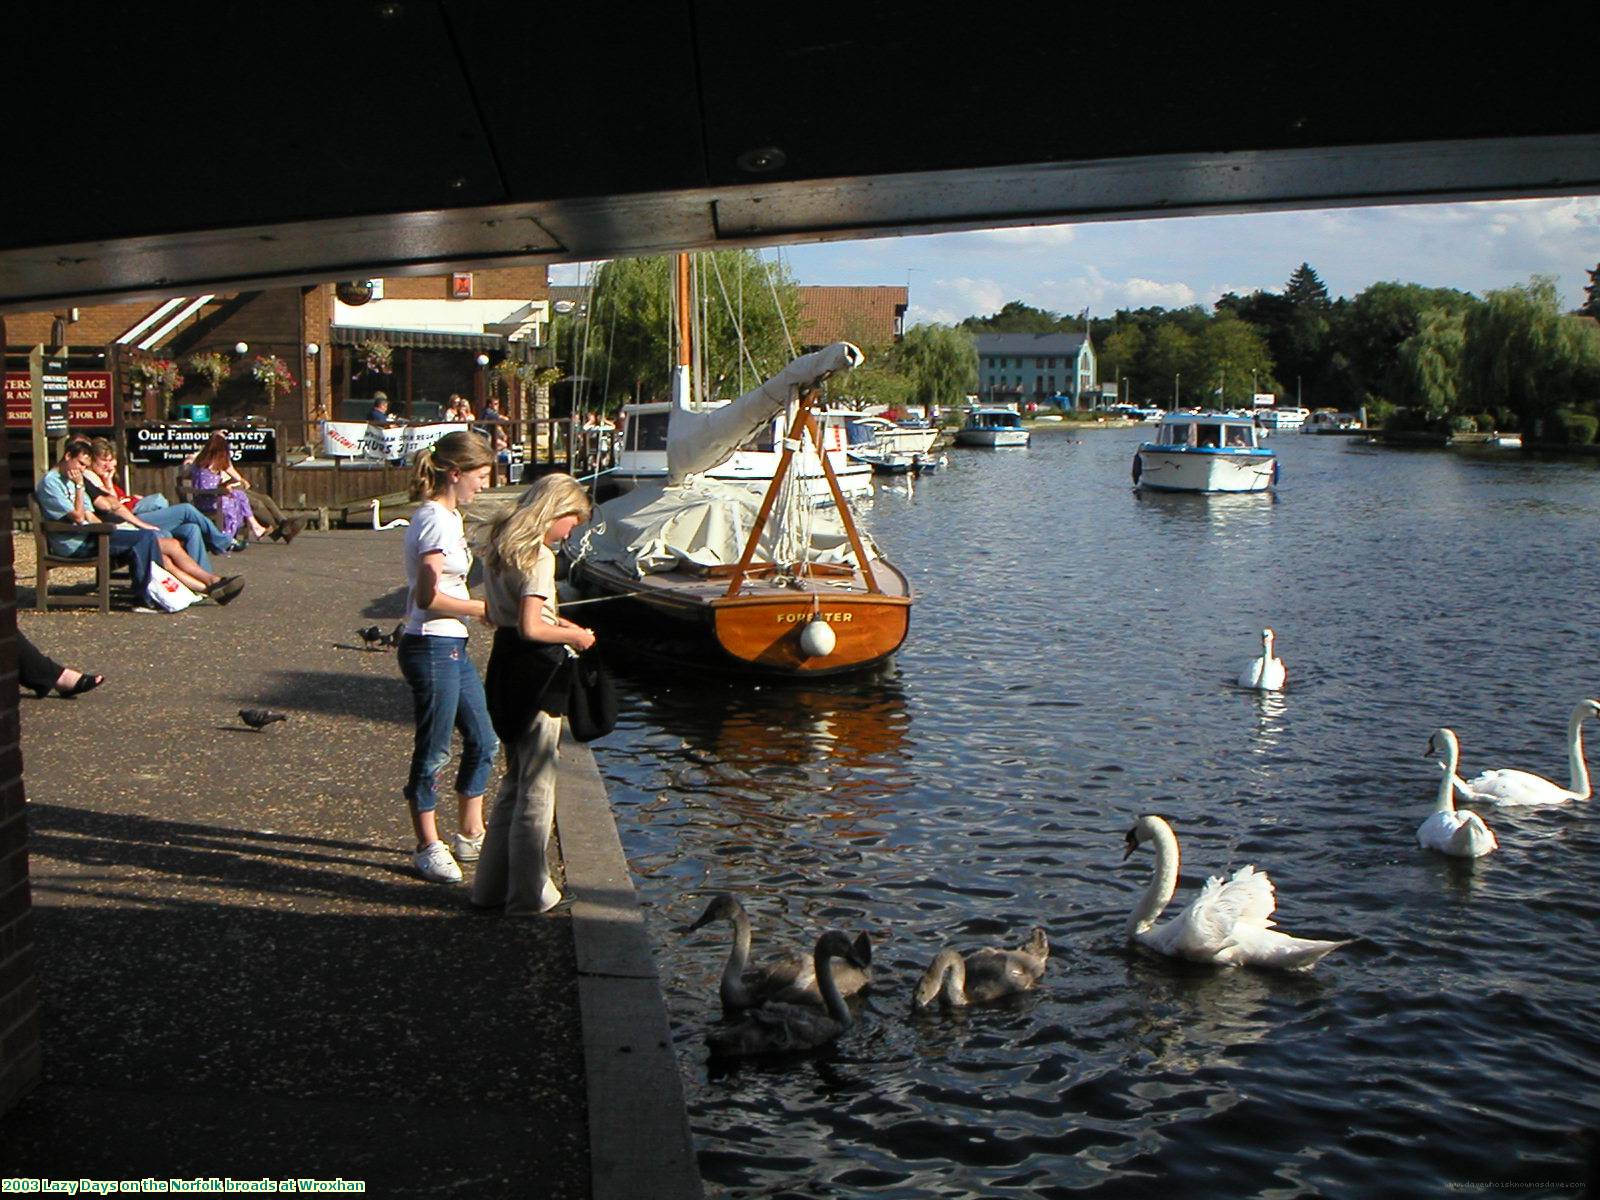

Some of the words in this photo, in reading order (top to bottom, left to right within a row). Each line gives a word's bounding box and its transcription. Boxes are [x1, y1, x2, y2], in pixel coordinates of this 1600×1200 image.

[67, 380, 106, 389] RRACE
[138, 429, 164, 440] Our
[167, 429, 212, 440] Famou
[356, 440, 393, 455] THURS
[777, 612, 853, 623] FORETER
